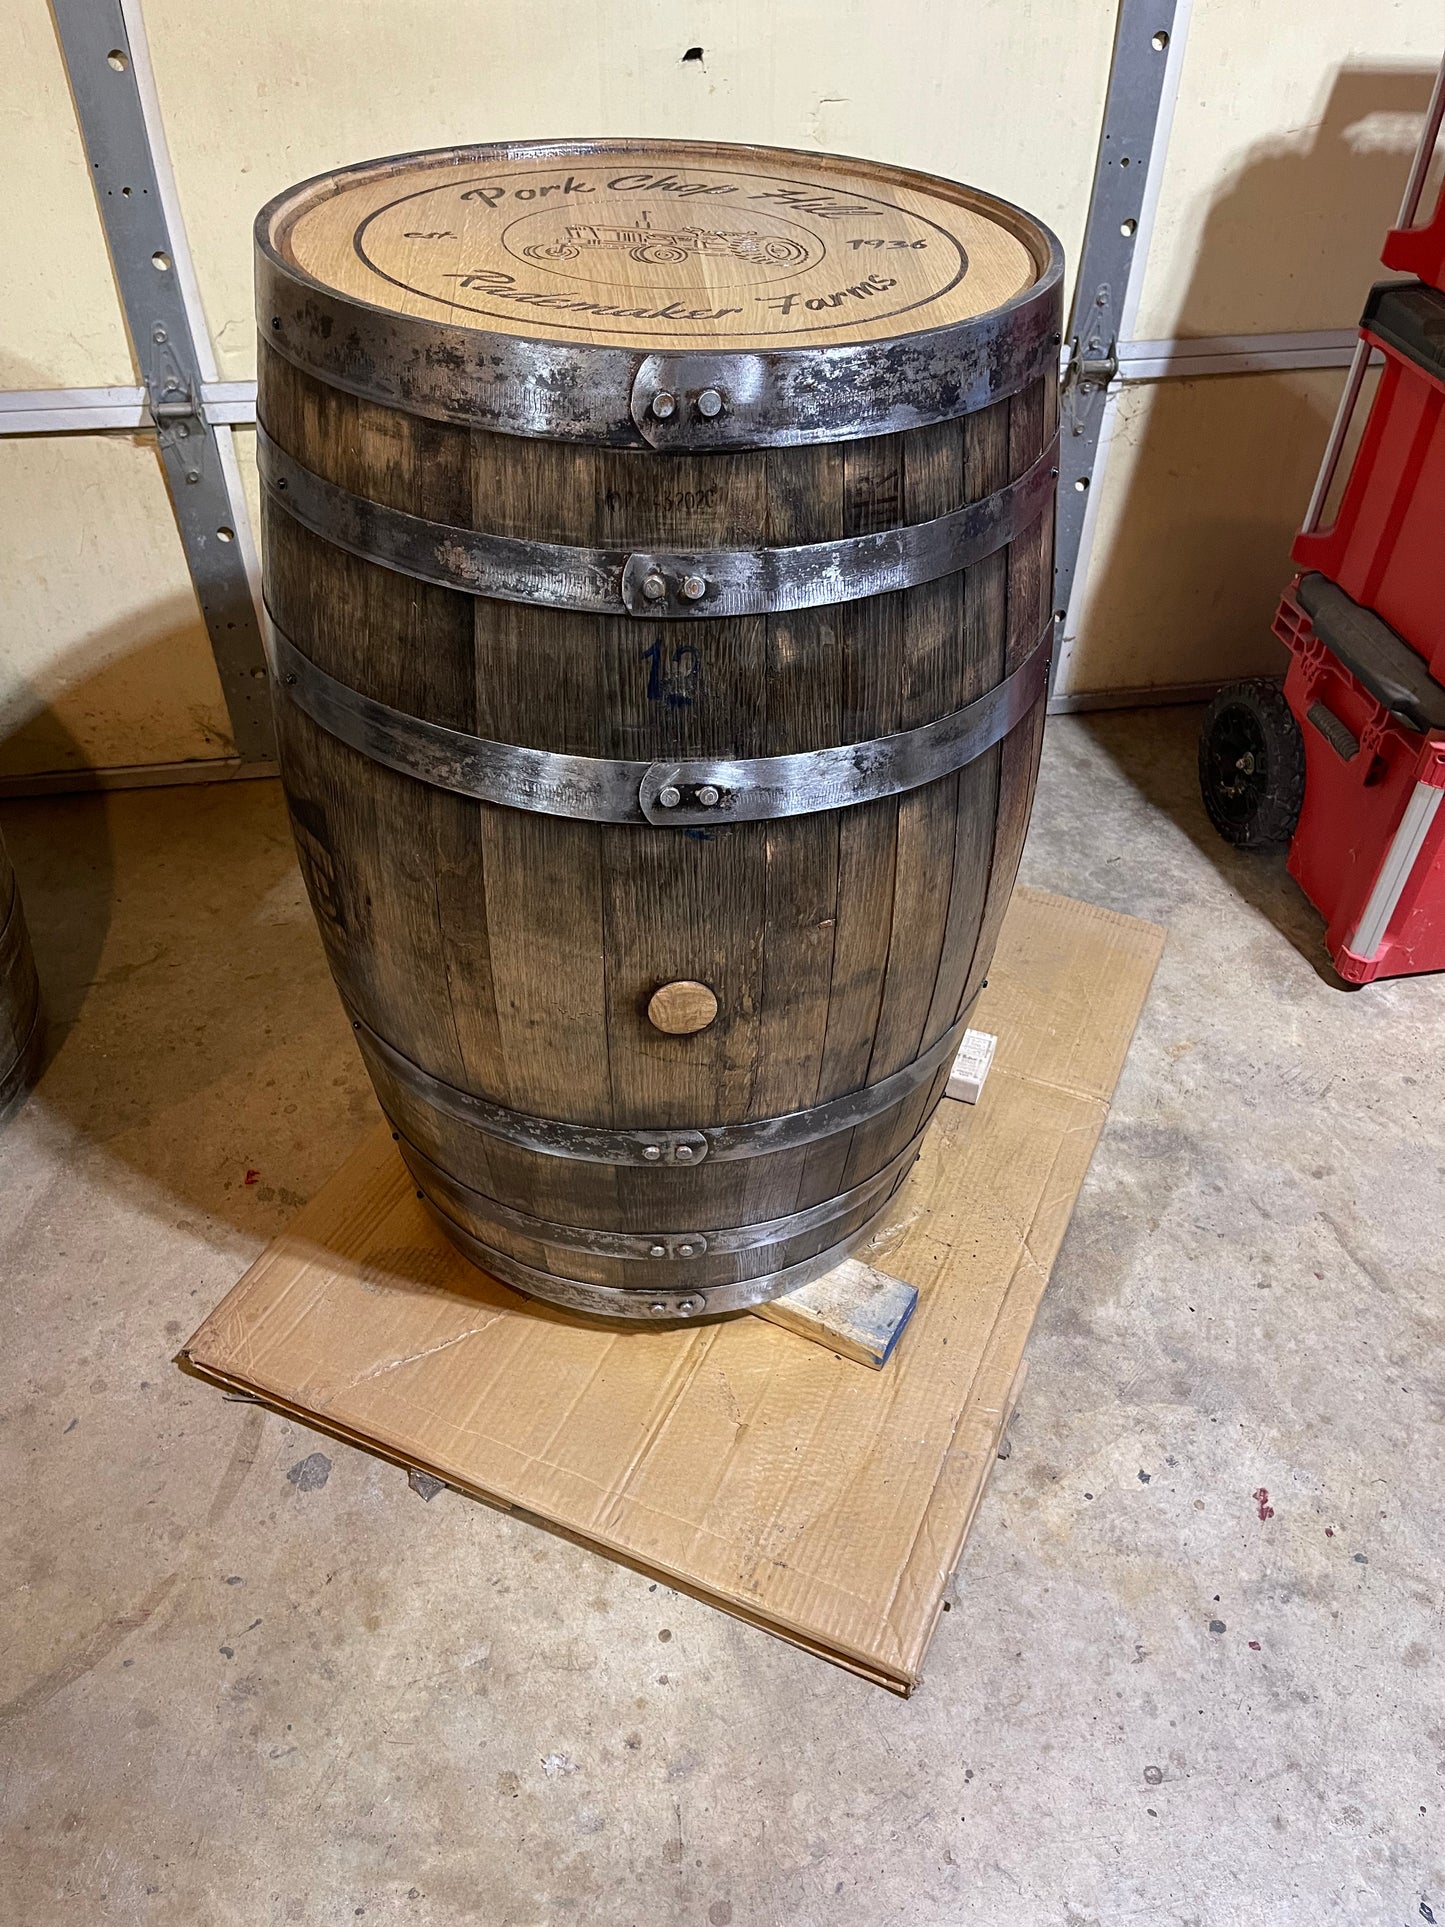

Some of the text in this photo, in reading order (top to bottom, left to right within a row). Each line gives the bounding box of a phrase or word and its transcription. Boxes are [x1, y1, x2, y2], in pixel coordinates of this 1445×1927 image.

[460, 174, 884, 219] Pork Chop Hill
[845, 238, 928, 251] 1936
[442, 269, 897, 319] Rademaker Farms
